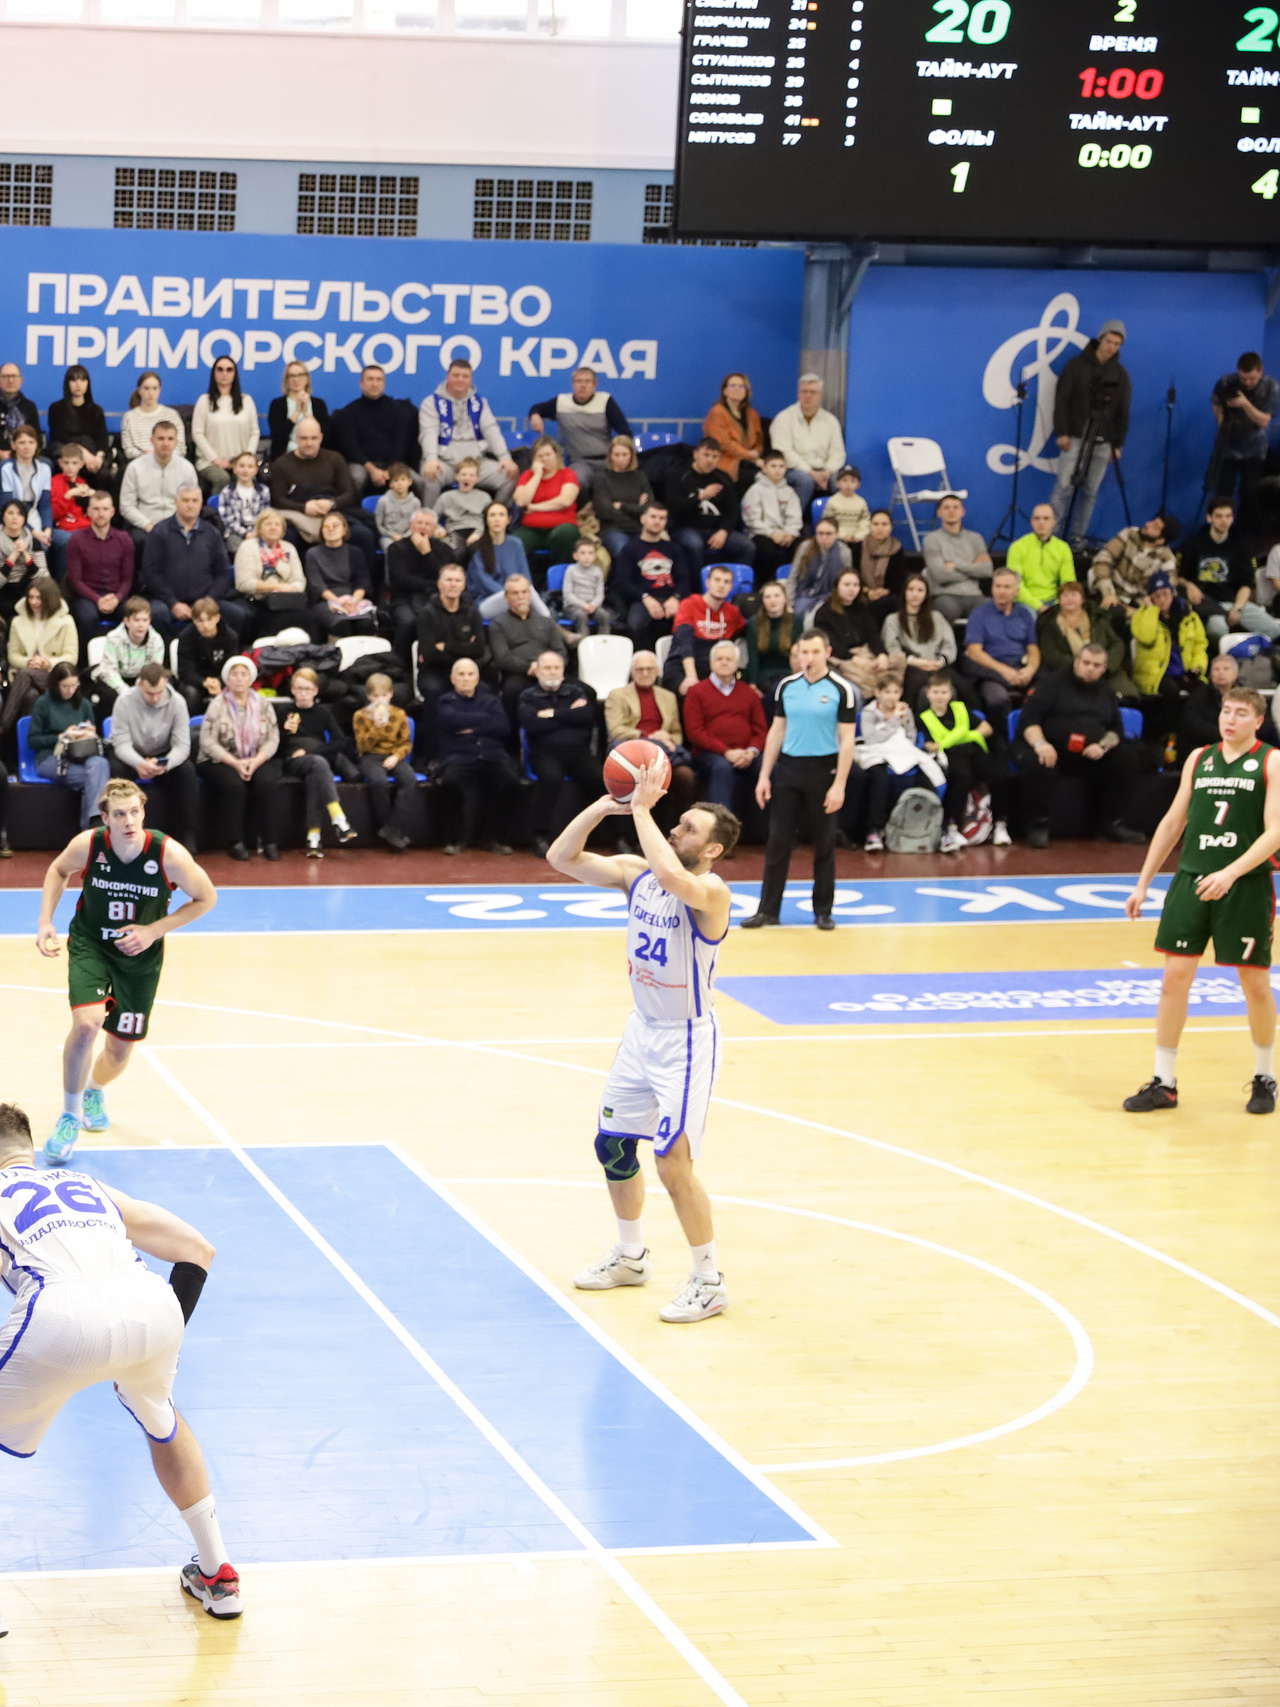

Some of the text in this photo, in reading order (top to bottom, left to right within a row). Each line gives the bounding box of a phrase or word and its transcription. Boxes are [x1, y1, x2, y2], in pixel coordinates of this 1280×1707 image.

[851, 0, 865, 13] 0
[1113, 0, 1138, 23] 2
[693, 15, 863, 33] КОРЧАГИН 24 6
[924, 0, 1012, 45] 20
[1235, 6, 1280, 53] 2
[692, 34, 749, 48] ГРАЧЕВ
[849, 38, 862, 52] 0
[1088, 34, 1159, 53] ВРЕМЯ
[691, 53, 776, 69] СТУЛЕНКОВ
[848, 58, 861, 71] 4
[915, 57, 1019, 80] ТАЙМ-АУТ
[690, 73, 772, 88] СЫТНИКОВ
[846, 77, 860, 90] 0
[1078, 67, 1165, 100] 1:00
[1226, 66, 1280, 87] ТАЙМ
[845, 96, 859, 109] 0
[688, 111, 765, 126] СОЛОВЬЕВ
[783, 114, 802, 127] 41
[1069, 110, 1169, 132] ТАЙМ-АУТ
[687, 130, 757, 145] МИТУСОВ
[781, 132, 802, 146] 77
[927, 128, 996, 147] ФОЛЫ
[1077, 142, 1153, 170] 0:00
[950, 161, 971, 193] 1
[1251, 168, 1280, 200] 4
[27, 271, 553, 327] ПРАВИТЕЛЬСТВО
[25, 324, 659, 380] ПРИМОРСКОГО КРАЯ
[1194, 776, 1256, 792] ЛОКОМОТИВ
[1214, 800, 1231, 826] 7
[91, 876, 159, 898] ЛОКОМОТИВ
[108, 901, 137, 922] 81
[634, 931, 669, 968] 24
[1240, 936, 1257, 961] 7
[116, 1011, 146, 1035] 81
[0, 1180, 108, 1235] 26
